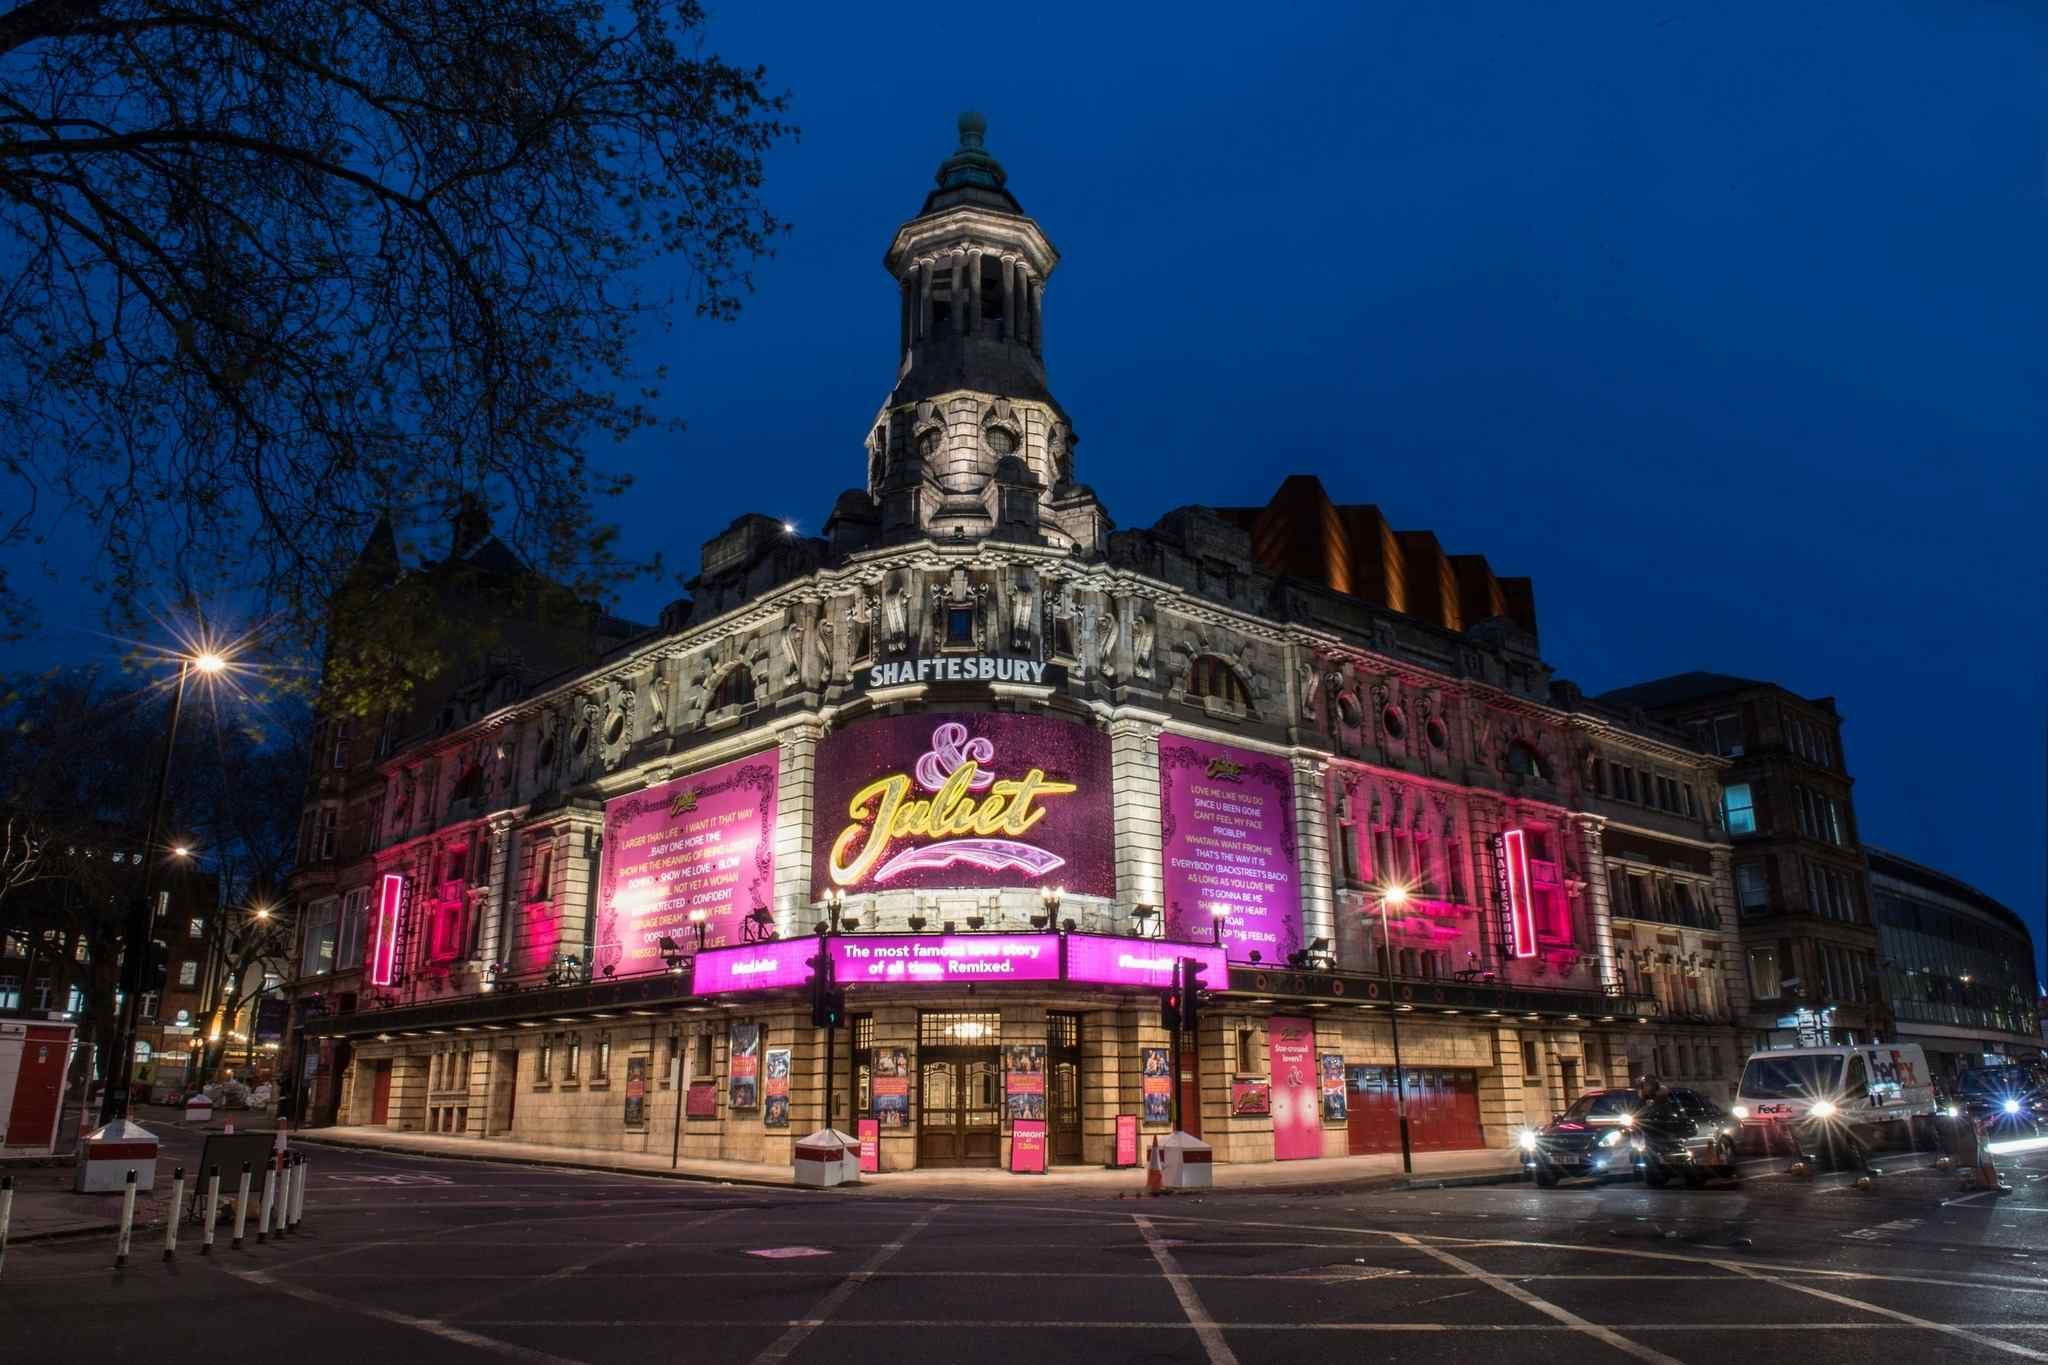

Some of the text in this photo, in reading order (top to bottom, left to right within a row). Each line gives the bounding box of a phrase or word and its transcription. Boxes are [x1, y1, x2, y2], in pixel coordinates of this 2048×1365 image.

[870, 657, 1046, 687] SHAFTESBURY
[1191, 784, 1263, 805] LOVE ME LIKE YOU DO
[1194, 796, 1215, 809] SINCE
[1222, 802, 1240, 814] BEEN
[1242, 806, 1260, 818] GONE
[622, 835, 646, 849] LARGER
[648, 830, 664, 843] THAN
[665, 826, 679, 838] LIFE
[689, 819, 709, 832] WANT
[710, 817, 717, 827] IT
[719, 812, 736, 825] THAT
[737, 807, 754, 820] WAY
[829, 761, 1077, 885] Juliet
[1216, 813, 1232, 824] FEEL
[1234, 816, 1244, 826] MY
[1246, 819, 1263, 830] FACE
[669, 839, 683, 851] ONE
[684, 834, 704, 848] MORE
[705, 830, 720, 842] TIME
[1213, 825, 1246, 839] PROBLEM
[1220, 839, 1240, 851] WANT
[1242, 843, 1262, 854] FROM
[1264, 846, 1272, 856] ME
[619, 864, 637, 877] SHOW
[638, 862, 648, 872] ME
[650, 859, 661, 870] THE
[662, 852, 692, 867] MEANING
[693, 849, 703, 860] OF
[1220, 851, 1234, 862] THE
[1236, 854, 1250, 864] WAY
[1251, 856, 1257, 865] IT
[1258, 857, 1264, 866] IS
[660, 868, 680, 881] SHOW
[681, 866, 692, 877] ME
[692, 862, 710, 874] LOVE
[718, 855, 740, 869] BLOW
[1172, 857, 1214, 871] EVERYBODY
[1268, 871, 1287, 882] BACK)
[673, 881, 689, 894] NOT
[690, 878, 701, 890] YET
[709, 870, 738, 886] WOMAN
[1188, 873, 1274, 892] AS LONG AS YOU LOVE ME
[692, 887, 732, 904] CONFIDENT
[1215, 889, 1241, 900] GONNA
[1242, 892, 1251, 901] BE
[1252, 894, 1263, 903] ME
[1224, 916, 1244, 927] ROAR
[672, 926, 684, 938] DID
[684, 925, 691, 936] IT
[1215, 928, 1232, 938] TOP
[1234, 930, 1247, 939] THE
[711, 935, 726, 947] LIFE
[844, 945, 870, 957] The
[874, 946, 909, 957] most
[868, 960, 885, 974] of
[887, 960, 904, 974] all
[948, 959, 1014, 973] Remixed.
[1758, 1104, 1792, 1114] FedEx
